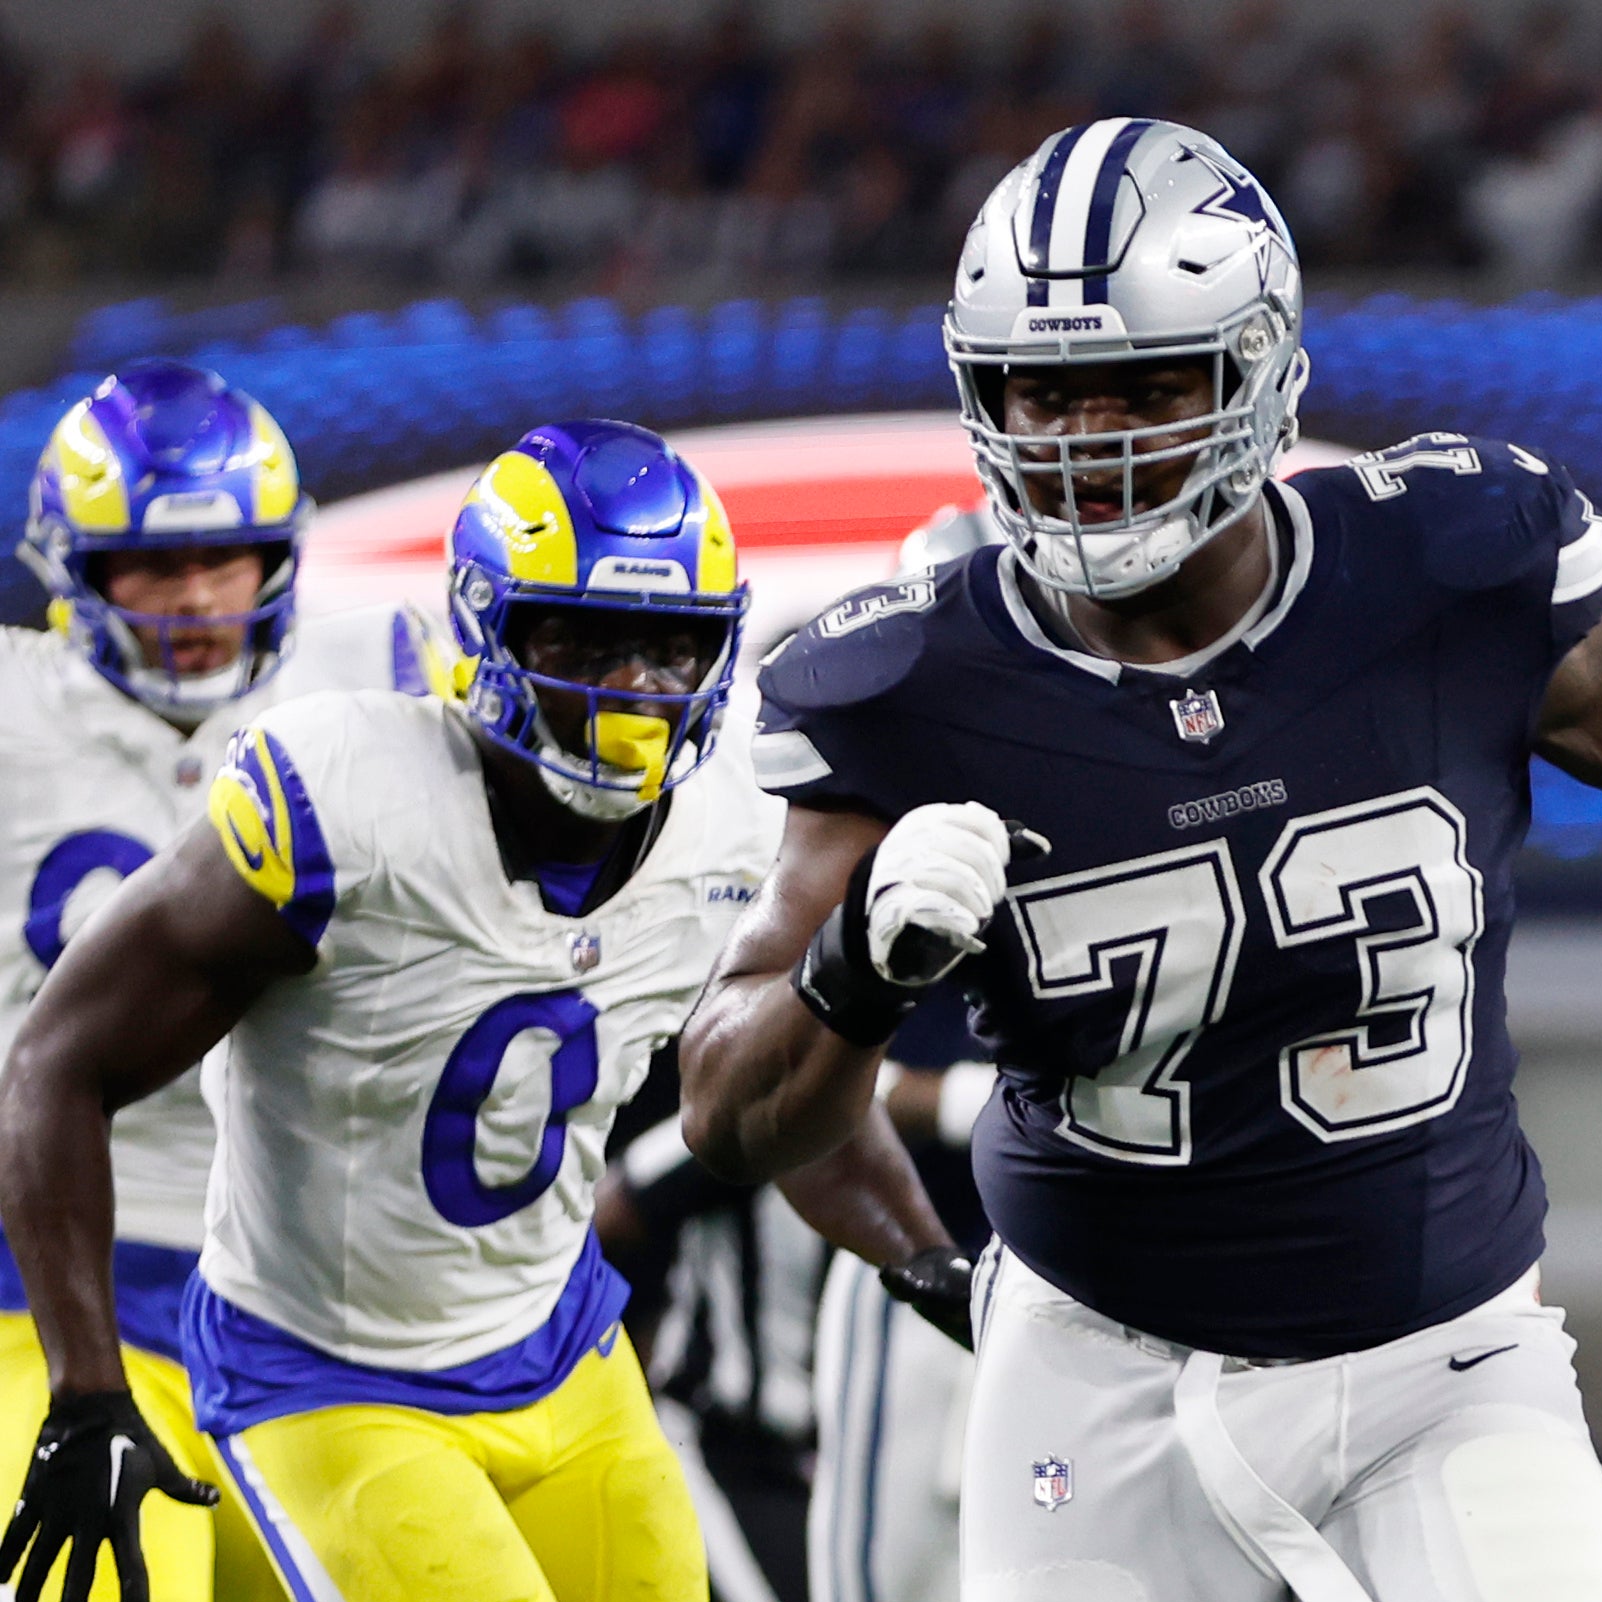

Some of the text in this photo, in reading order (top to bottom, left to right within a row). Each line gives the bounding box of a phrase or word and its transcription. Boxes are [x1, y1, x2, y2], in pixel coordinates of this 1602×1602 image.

[1028, 315, 1103, 333] COWBOYS
[1184, 711, 1217, 733] NFL
[1168, 778, 1289, 831] COWBOYS
[1005, 784, 1486, 1167] 73
[421, 987, 600, 1227] 0
